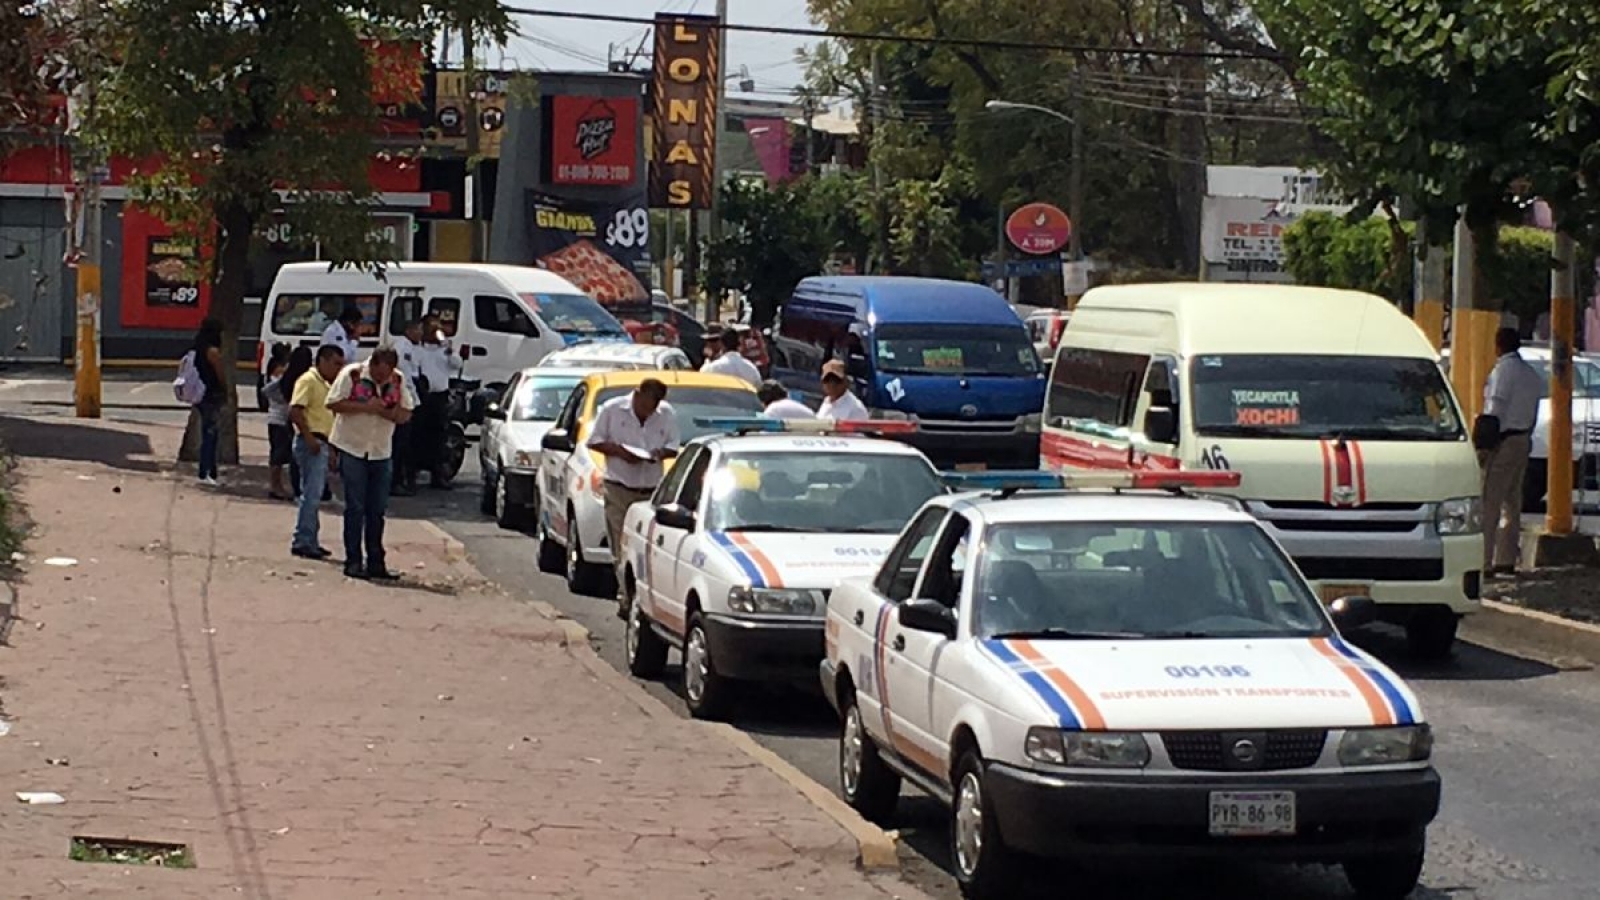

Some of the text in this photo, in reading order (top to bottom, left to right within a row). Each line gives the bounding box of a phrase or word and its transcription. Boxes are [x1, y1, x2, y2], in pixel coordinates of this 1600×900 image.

[664, 18, 700, 204] LONAS
[576, 119, 613, 145] Pizza
[583, 133, 608, 155] Hut
[605, 207, 649, 248] $89
[1236, 407, 1298, 425] XOCHI
[1201, 443, 1230, 470] 16
[1164, 664, 1252, 679] 00196
[1223, 686, 1352, 698] TRANSPORTES
